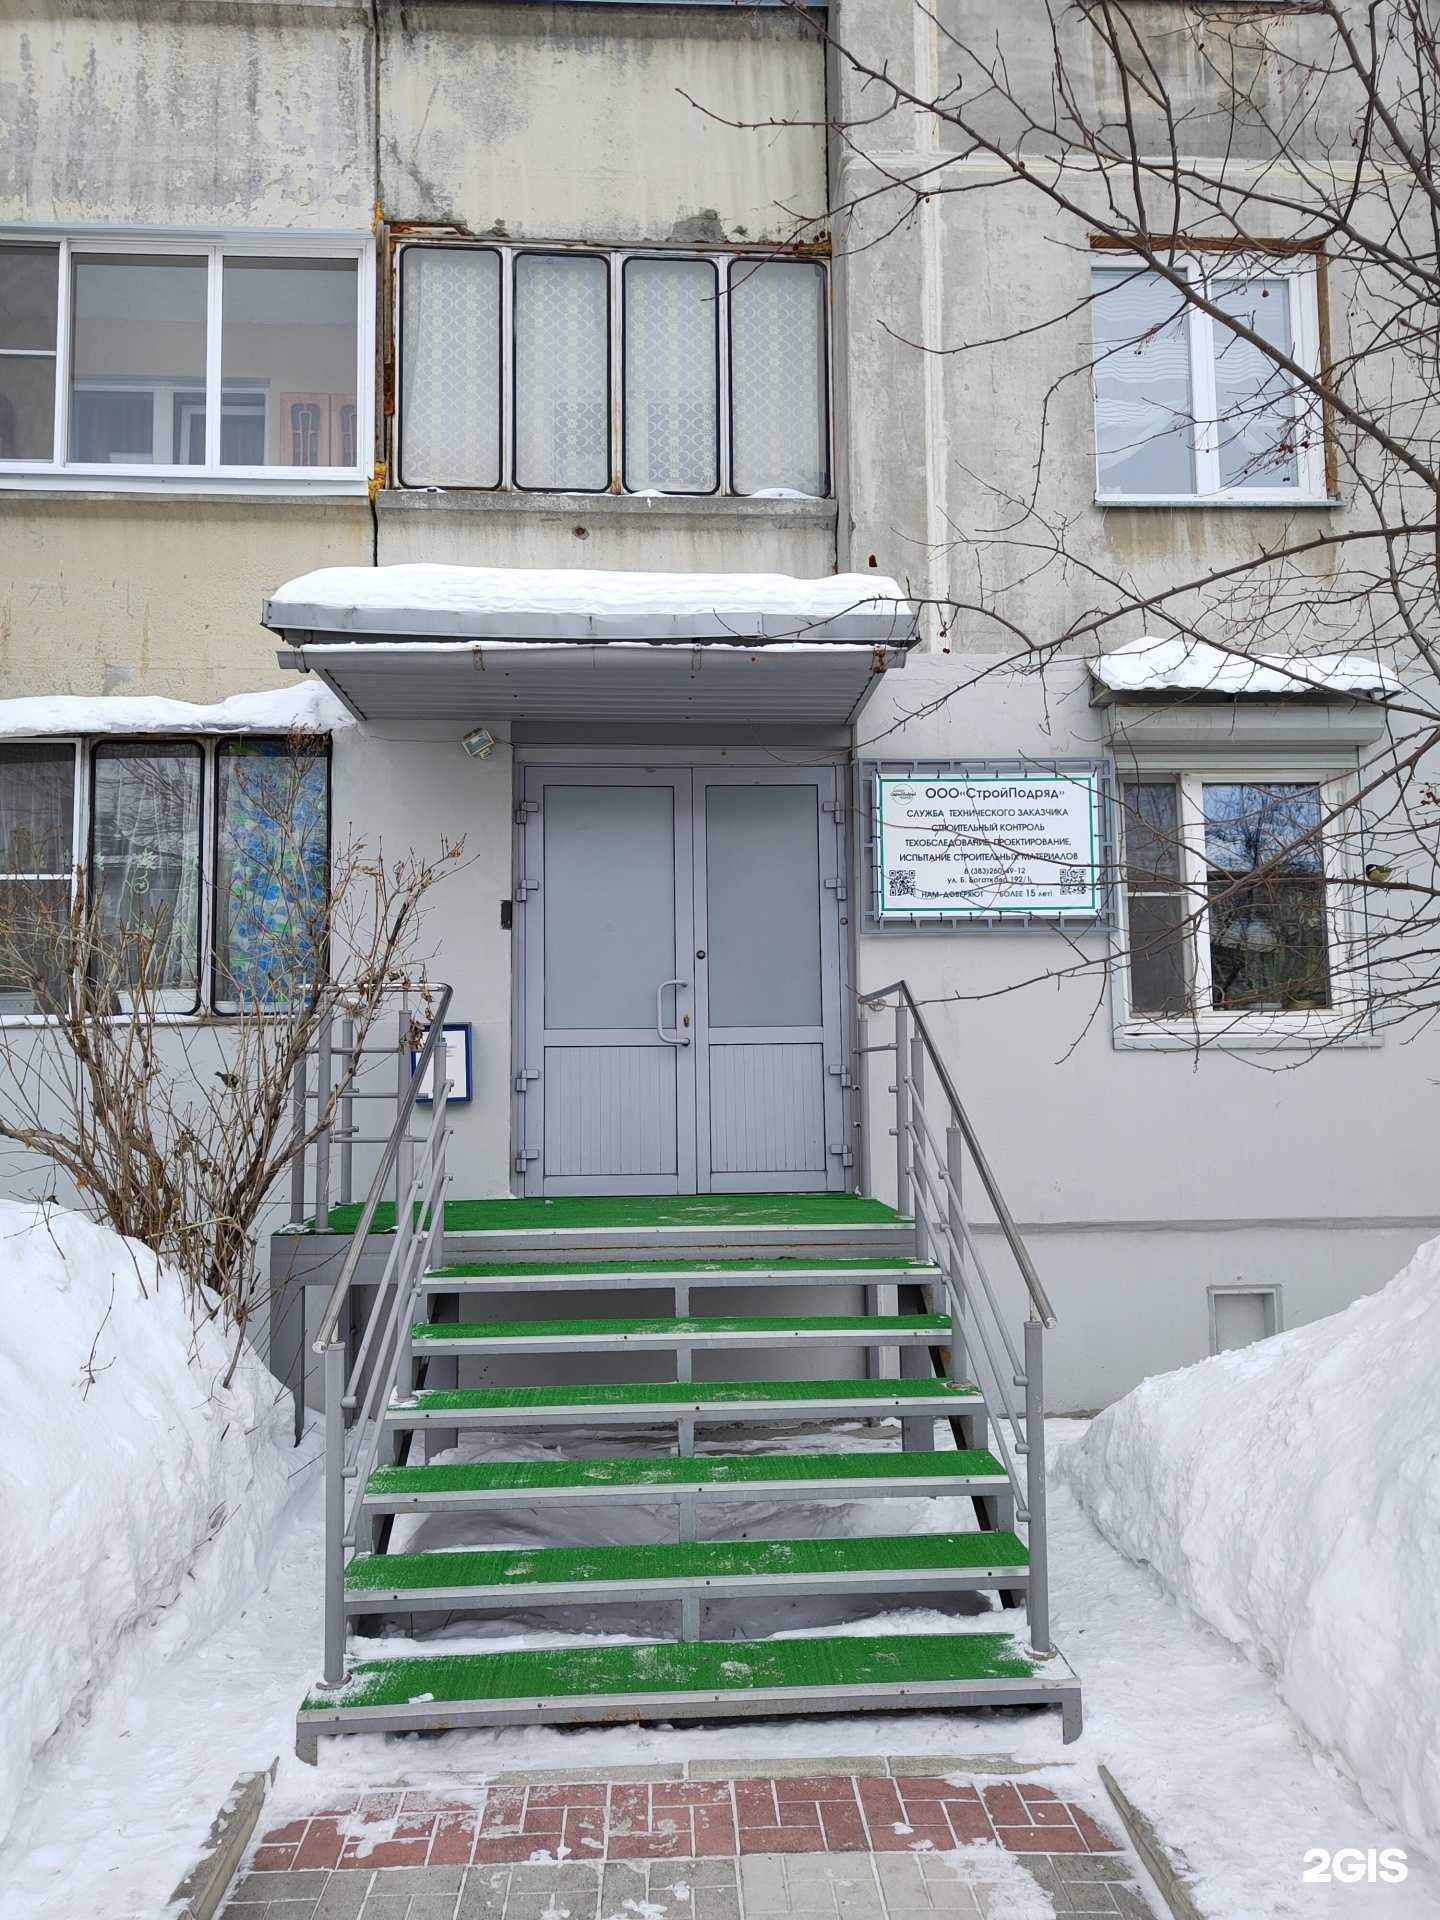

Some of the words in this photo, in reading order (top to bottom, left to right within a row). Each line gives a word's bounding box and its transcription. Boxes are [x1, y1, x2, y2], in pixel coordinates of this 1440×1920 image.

[906, 809, 944, 818] СЛУЖБА
[949, 808, 1016, 817] ТЕХНИЧЕСКОГО
[1017, 808, 1069, 817] ЗАКАЗЧИКА
[1000, 823, 1045, 832] КОНТРОЛЬ
[899, 853, 951, 862] ИСПЫТАНИЕ
[999, 889, 1024, 898] БОЛЕЕ
[1026, 888, 1036, 897] 15
